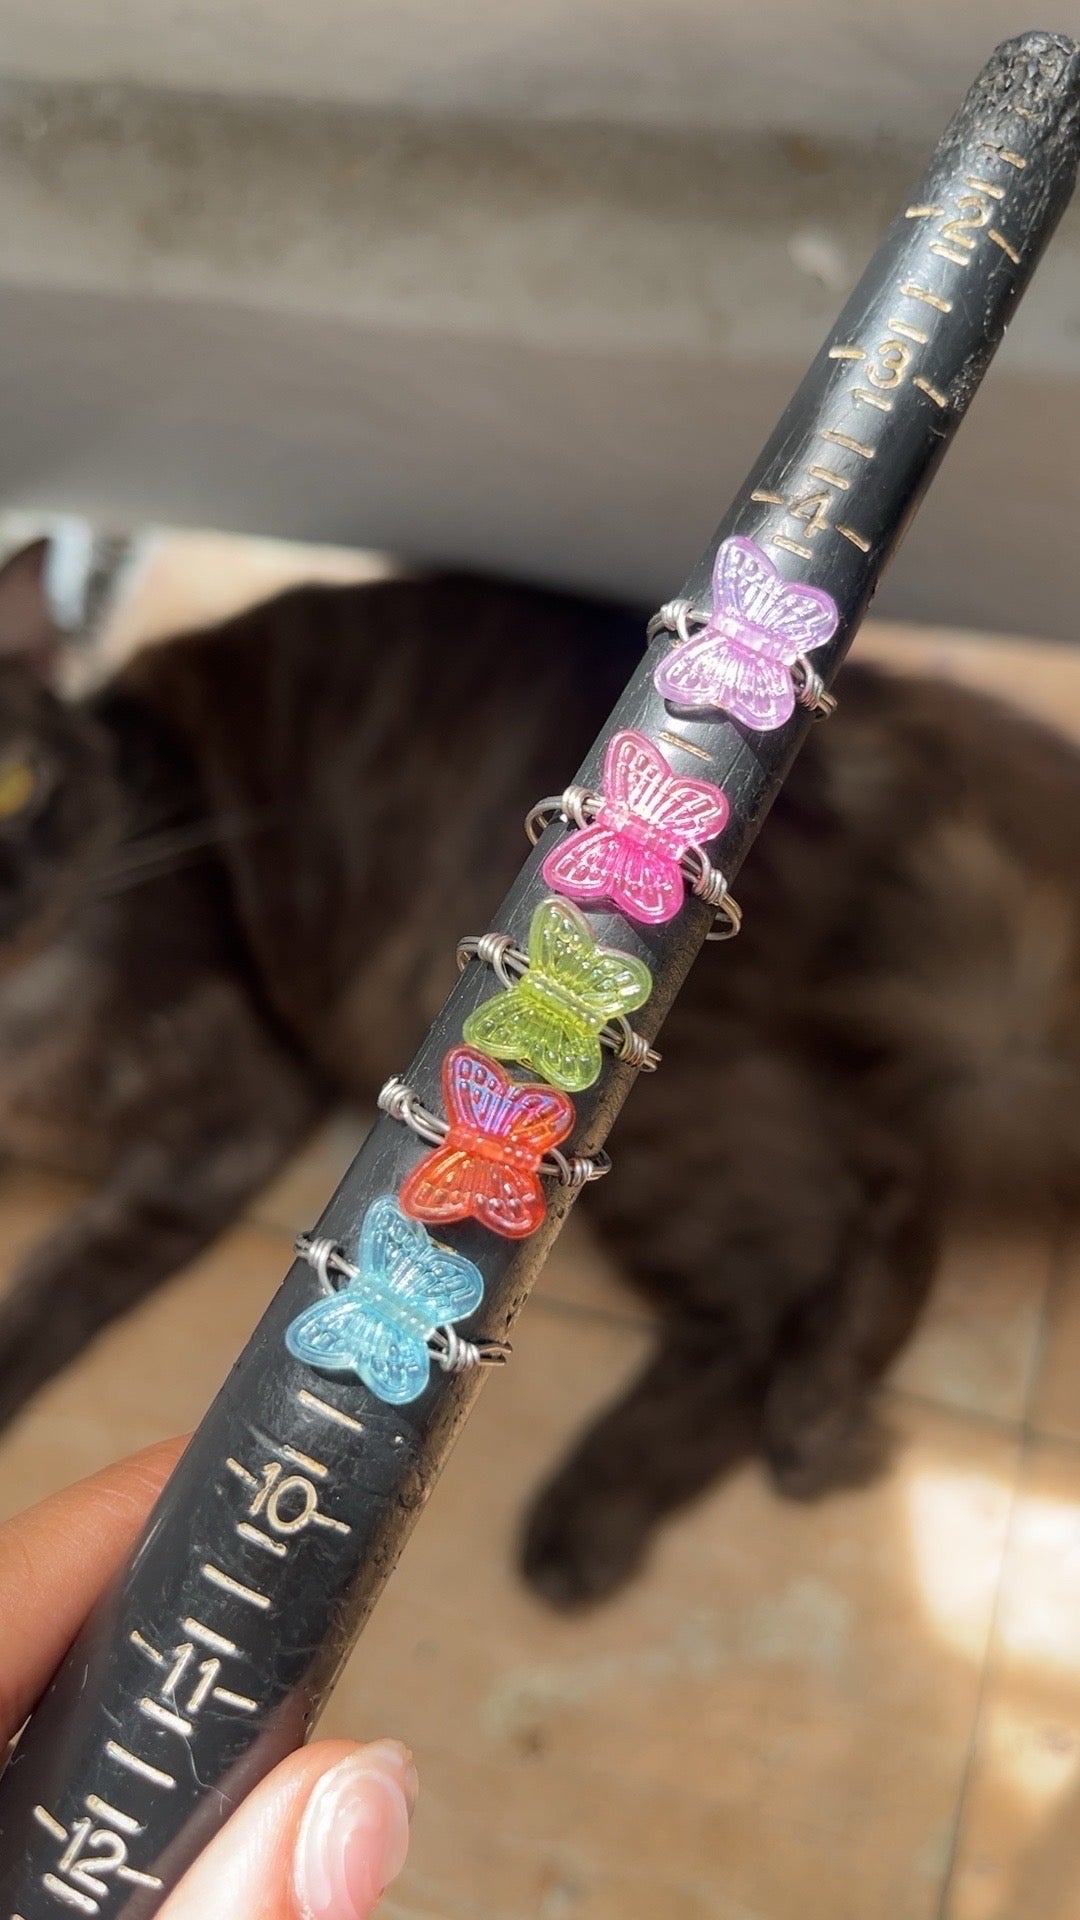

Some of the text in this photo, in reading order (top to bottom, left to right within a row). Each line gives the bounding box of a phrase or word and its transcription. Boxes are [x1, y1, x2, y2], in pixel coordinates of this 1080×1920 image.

[939, 196, 990, 250] 2
[863, 340, 913, 390] 3
[789, 491, 829, 538] 4
[249, 1462, 320, 1534] 10
[163, 1642, 222, 1712] 11
[59, 1817, 130, 1897] 12
